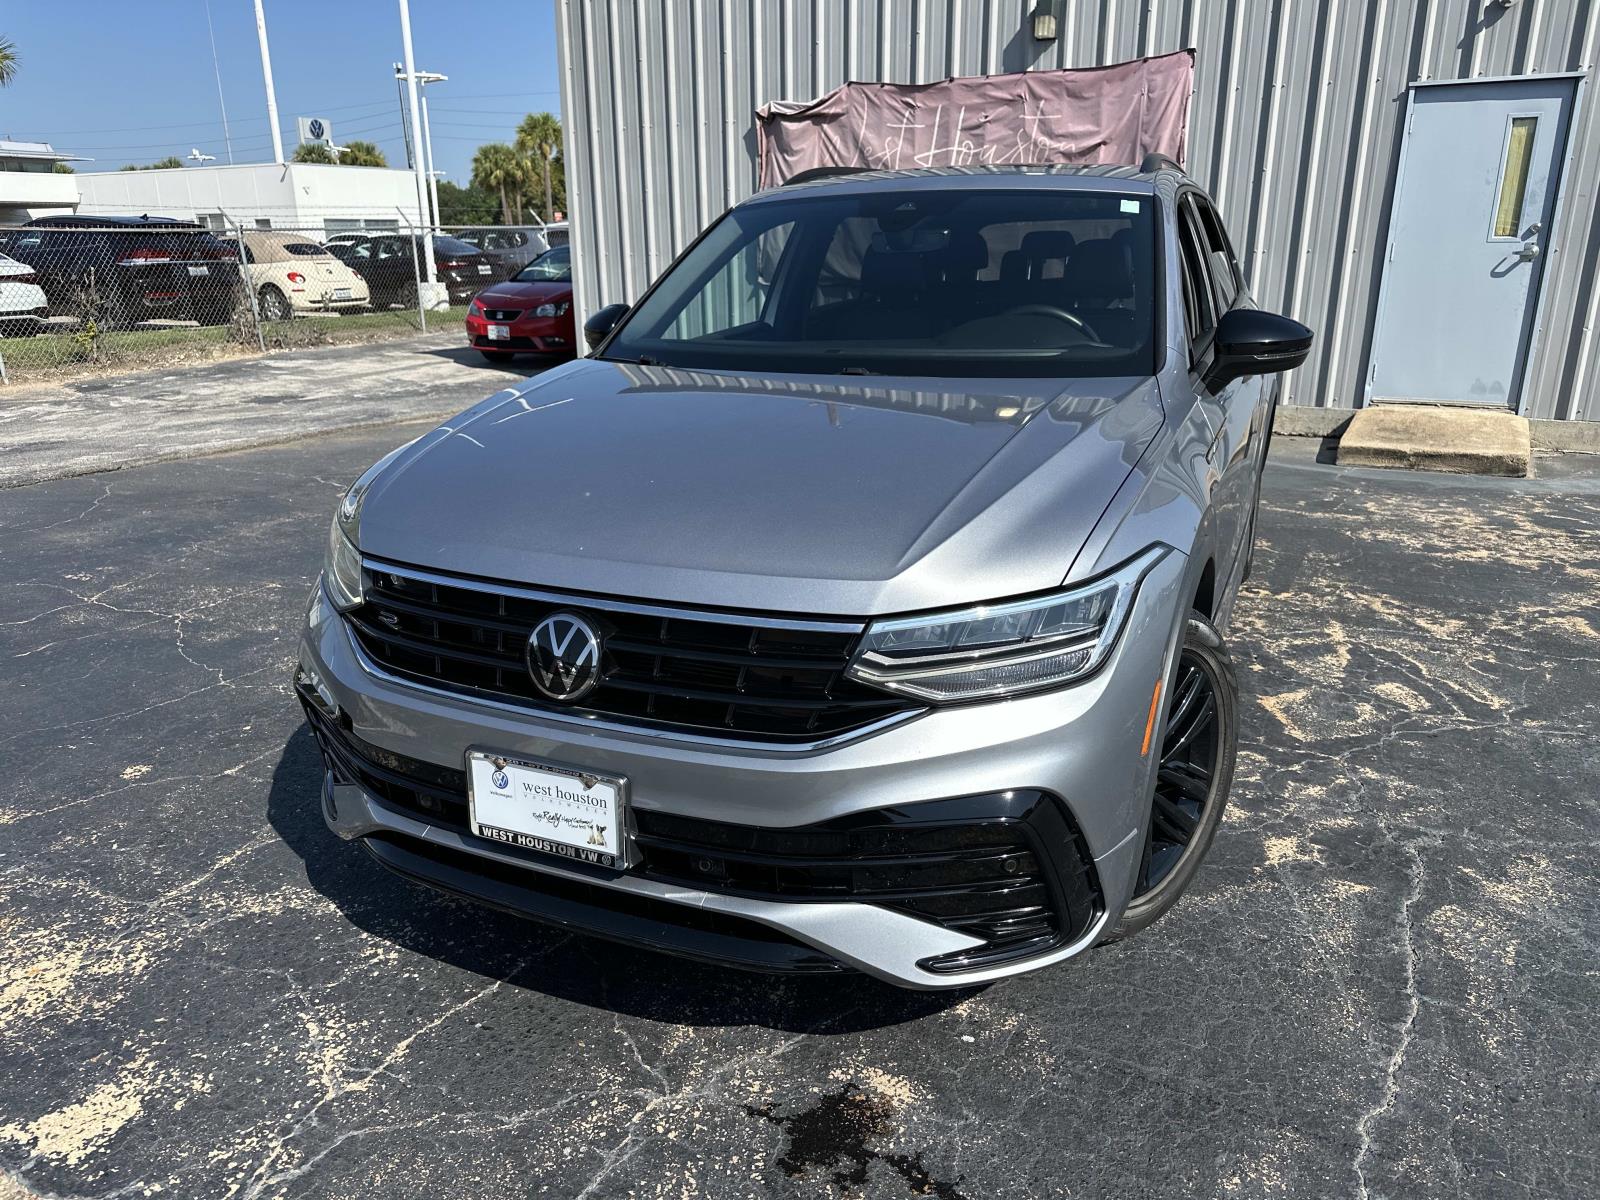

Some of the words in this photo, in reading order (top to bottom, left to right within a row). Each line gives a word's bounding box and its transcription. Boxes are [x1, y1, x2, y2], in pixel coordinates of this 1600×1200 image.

[522, 782, 552, 796] west
[556, 785, 607, 808] houston
[482, 826, 514, 842] WEST
[518, 836, 576, 857] HOUSTON
[578, 849, 598, 863] VW
